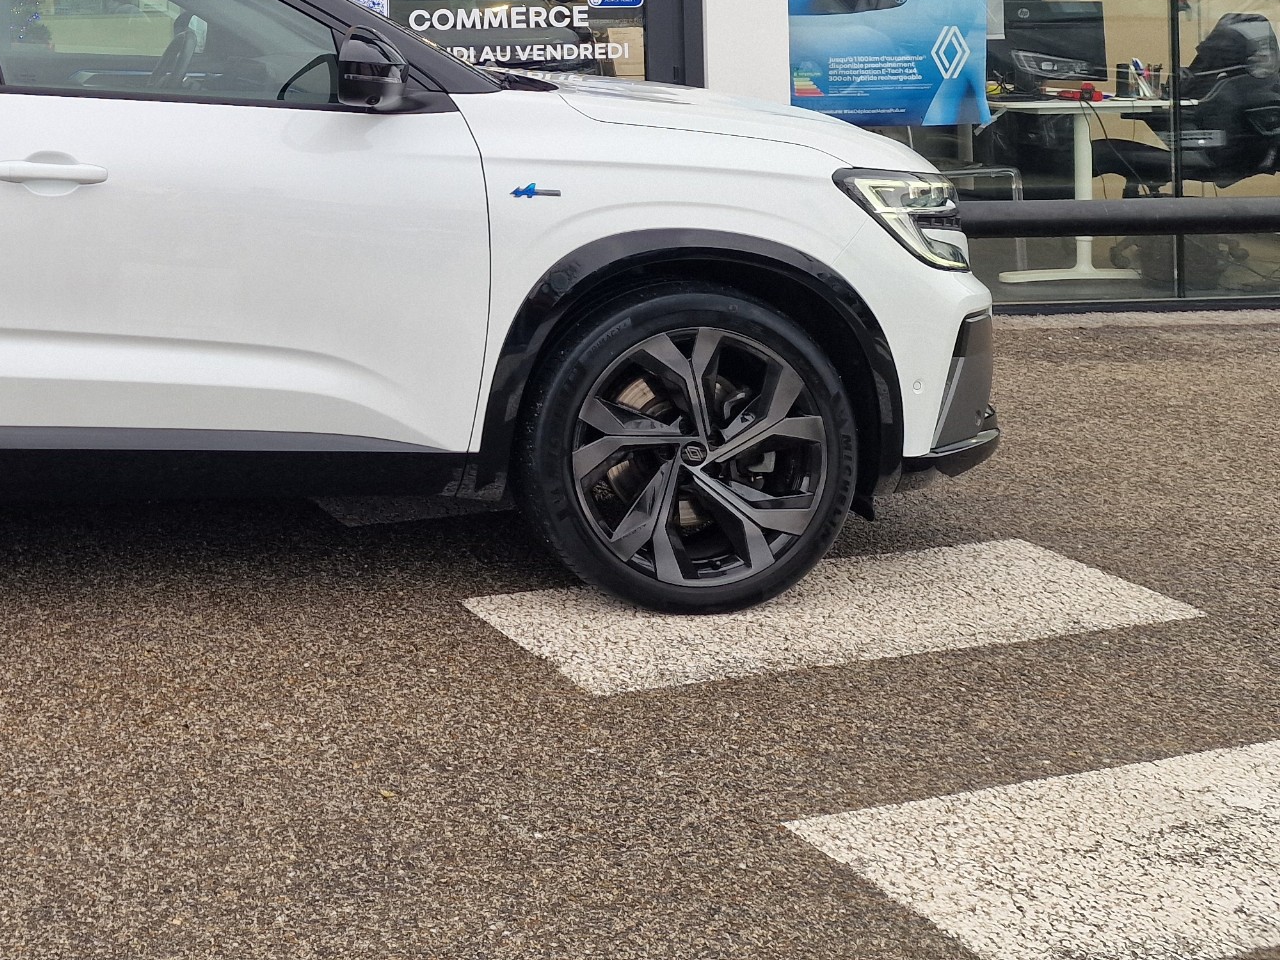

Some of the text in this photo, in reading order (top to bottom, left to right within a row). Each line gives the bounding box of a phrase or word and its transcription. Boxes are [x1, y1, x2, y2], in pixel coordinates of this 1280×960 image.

[408, 5, 590, 32] COMMERCE
[1018, 8, 1030, 19] hp
[479, 40, 511, 62] AU
[515, 42, 629, 61] VENDREDI
[828, 61, 915, 70] disponible prochainement
[852, 74, 877, 82] hybride
[877, 73, 923, 81] rechargeable
[818, 433, 853, 543] MICHELIN
